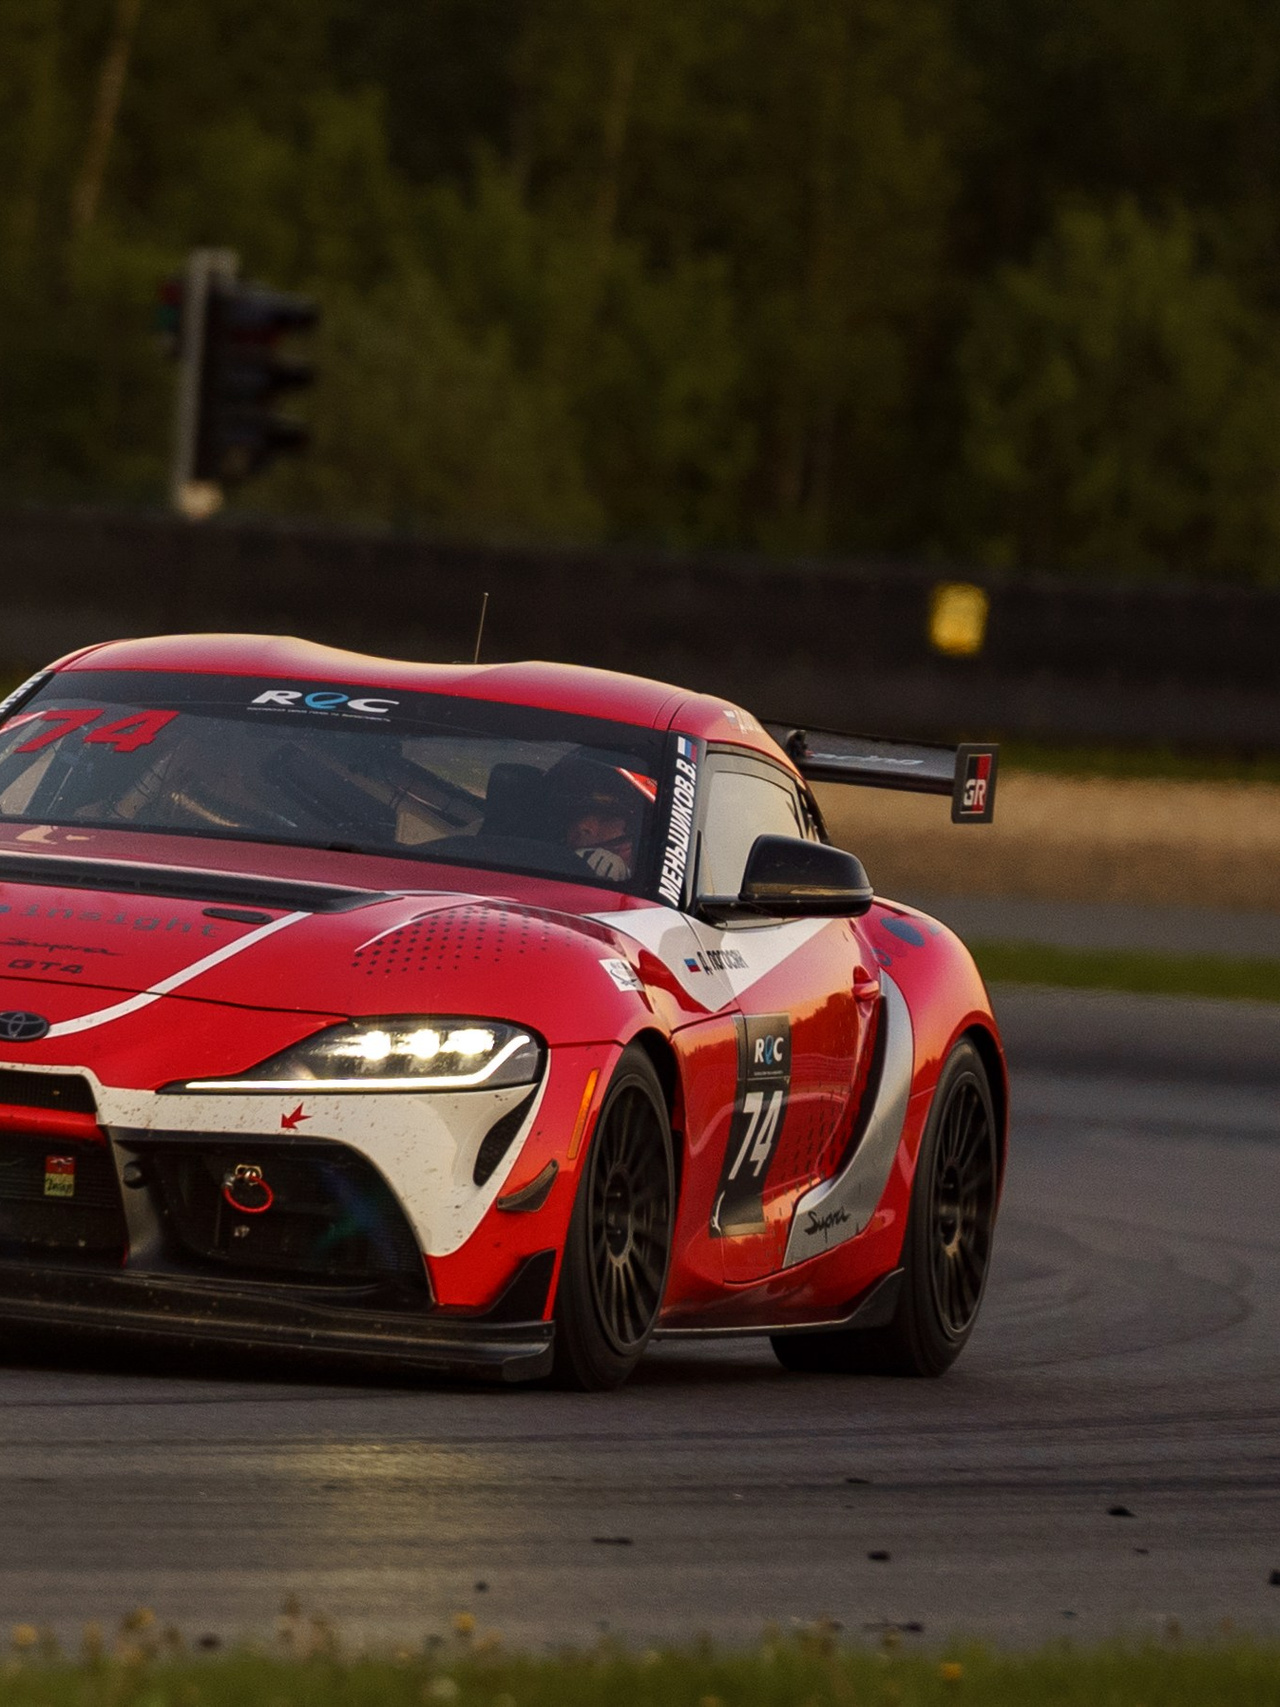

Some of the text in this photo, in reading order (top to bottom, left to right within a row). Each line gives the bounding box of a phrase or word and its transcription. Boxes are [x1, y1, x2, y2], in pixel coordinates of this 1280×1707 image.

[13, 708, 181, 753] 74
[963, 778, 987, 806] GR
[7, 958, 84, 974] GT4
[727, 1090, 784, 1181] 74
[804, 1205, 851, 1244] Supra
